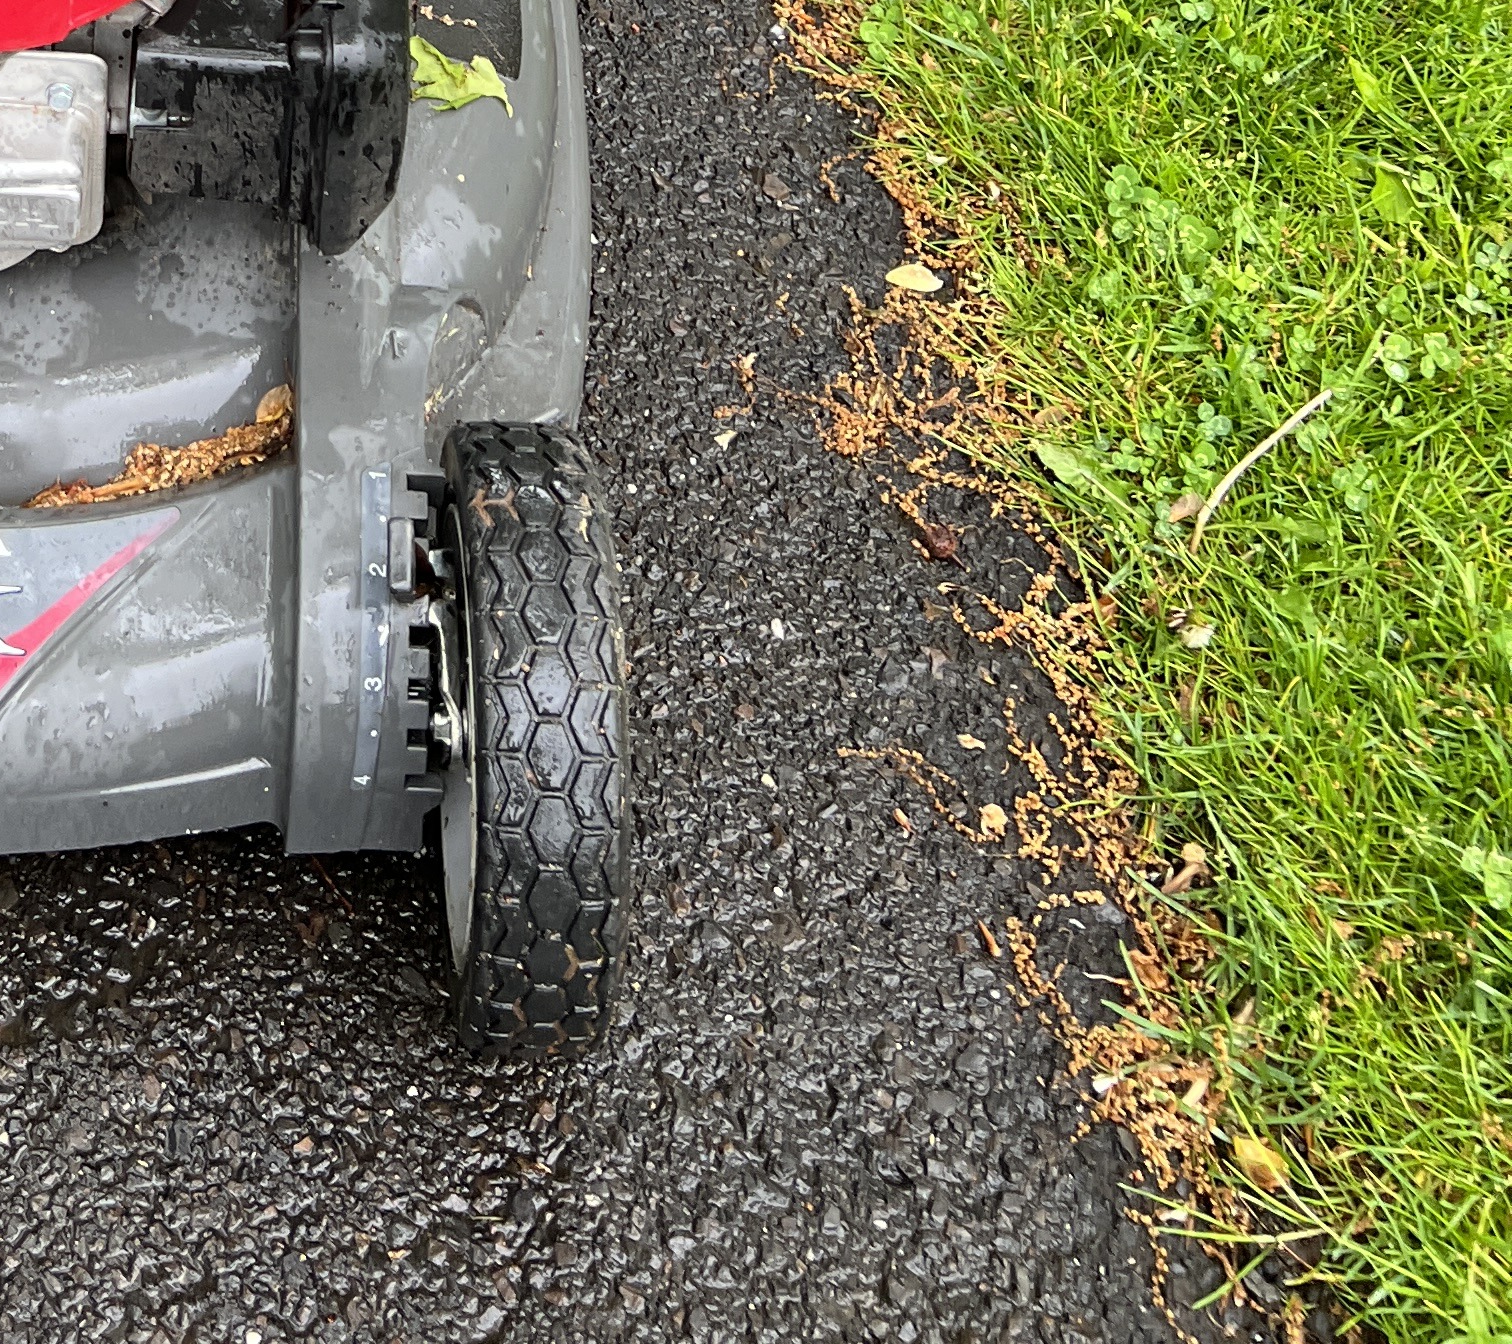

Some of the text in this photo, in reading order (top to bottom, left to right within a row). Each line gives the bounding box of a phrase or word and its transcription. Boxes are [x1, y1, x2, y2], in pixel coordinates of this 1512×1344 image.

[352, 471, 387, 786] 1 2 3 4
